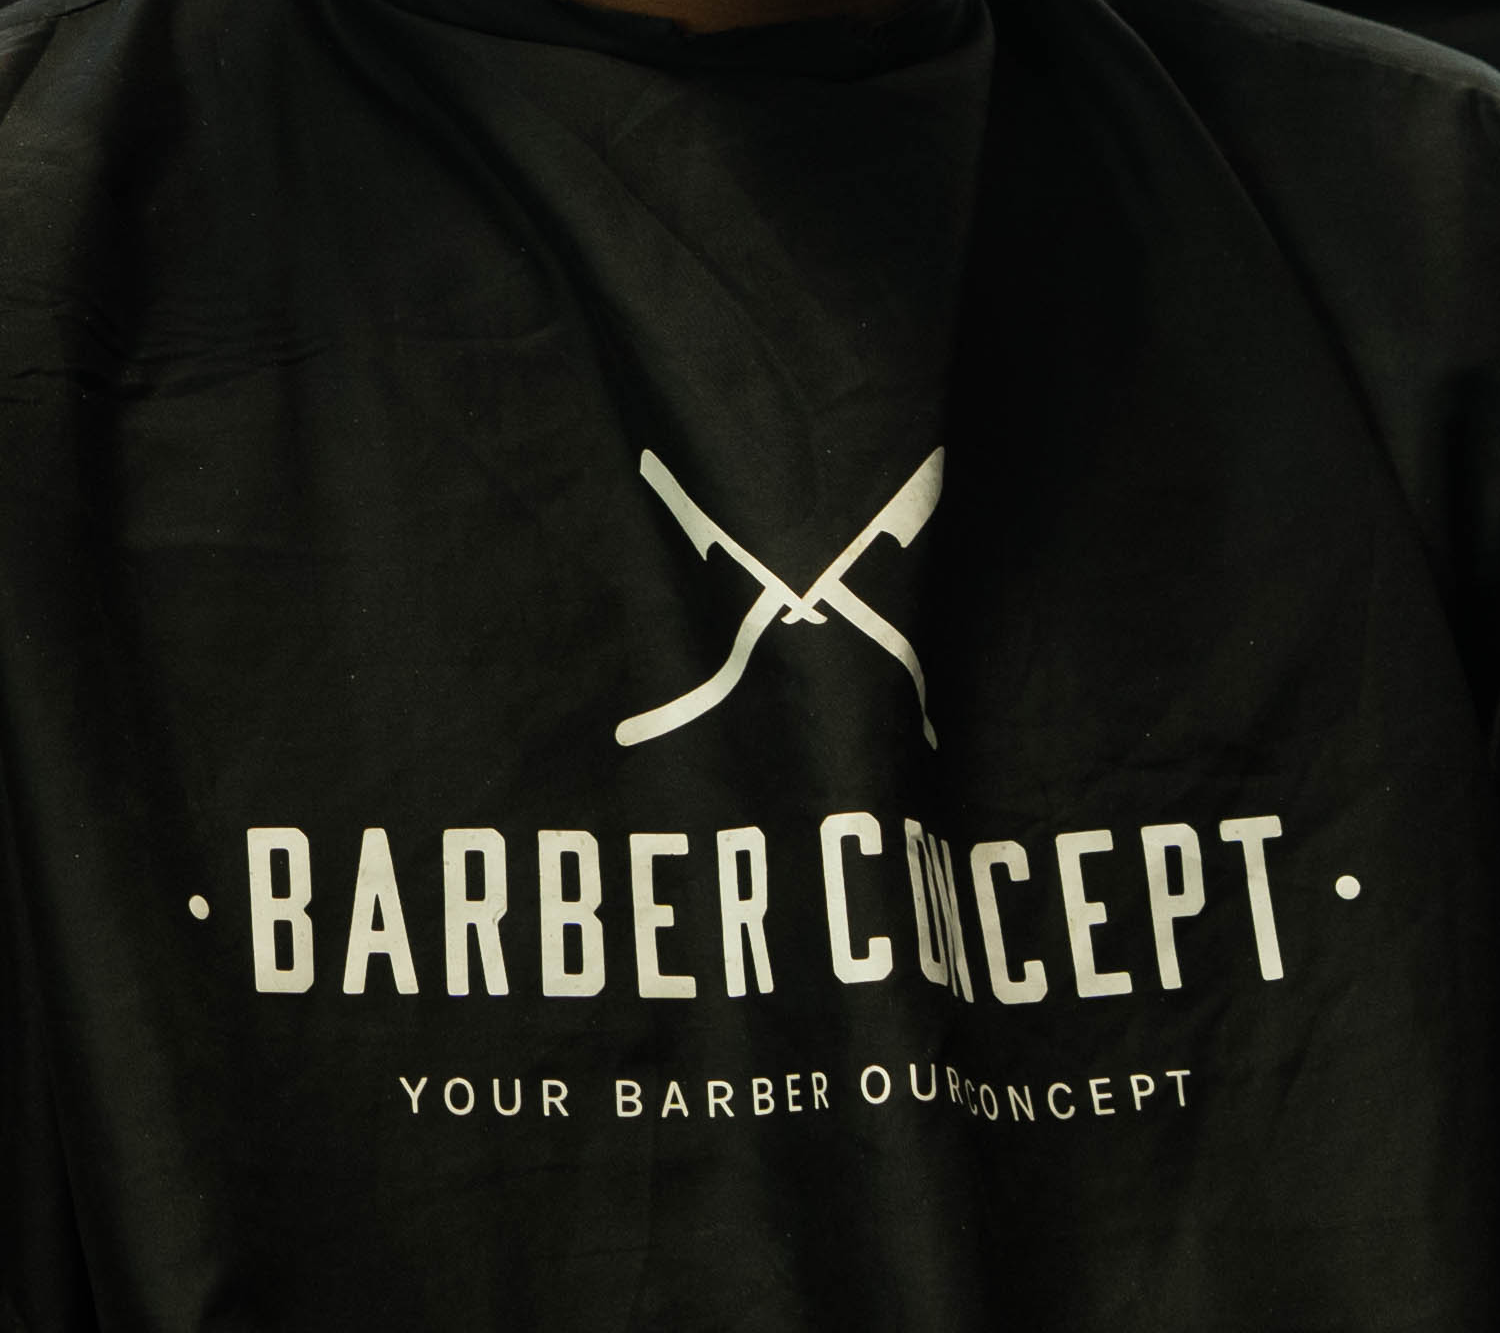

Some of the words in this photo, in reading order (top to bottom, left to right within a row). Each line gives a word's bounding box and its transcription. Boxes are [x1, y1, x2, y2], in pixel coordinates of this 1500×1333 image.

[246, 825, 775, 999] BARBER
[819, 811, 1285, 1006] CONCEPT
[398, 1076, 570, 1117] YOUR
[615, 1071, 830, 1119] BARBER
[860, 1062, 964, 1105] OUR
[963, 1069, 1191, 1122] CONCEPT
